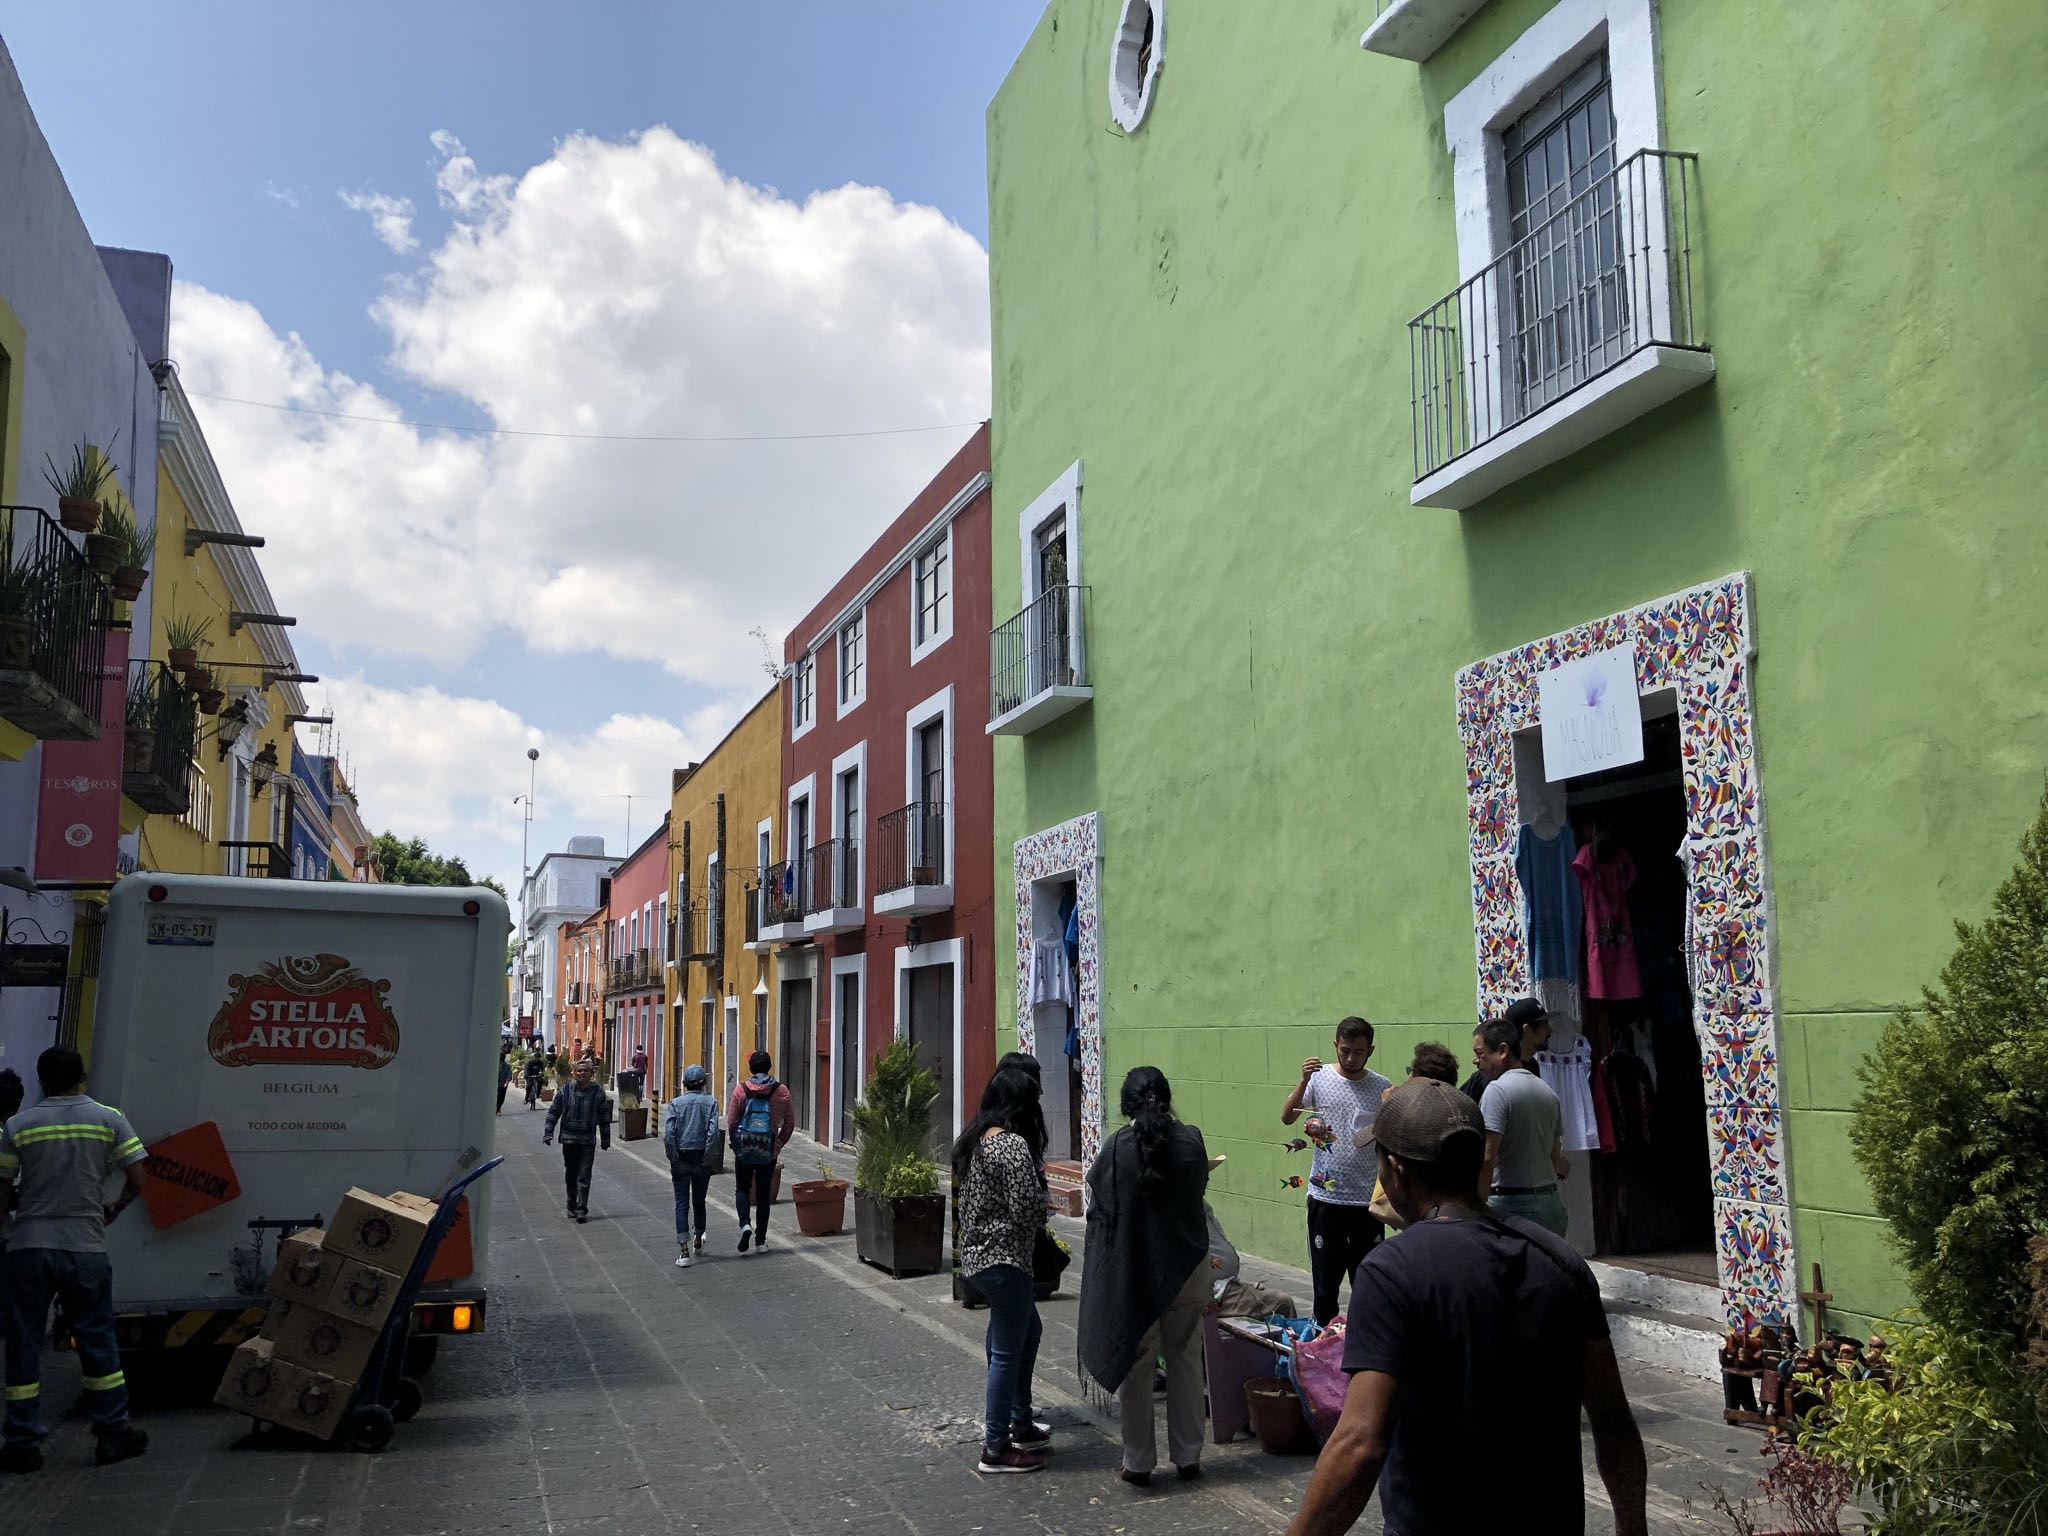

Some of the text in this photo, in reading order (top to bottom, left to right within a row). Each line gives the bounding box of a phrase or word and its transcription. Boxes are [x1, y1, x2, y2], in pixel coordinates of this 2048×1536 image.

[250, 1000, 366, 1023] STELLA
[247, 1026, 367, 1050] ARTOIS
[263, 1082, 338, 1094] BELGIUM
[248, 1121, 347, 1131] TODO CON MEDIDA
